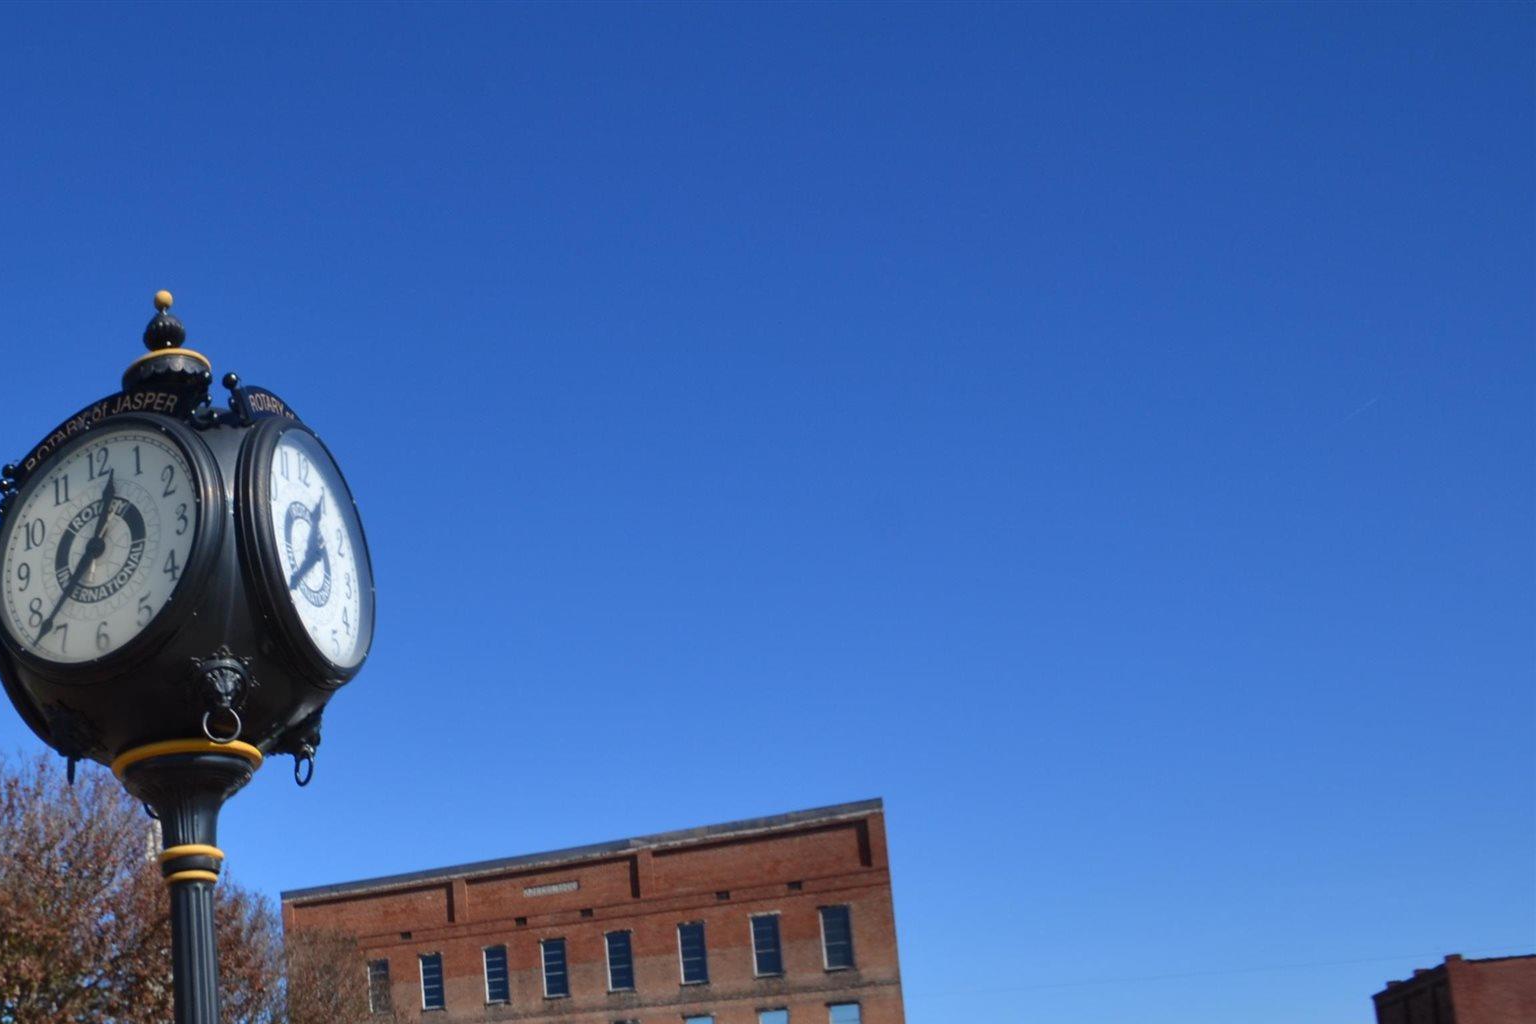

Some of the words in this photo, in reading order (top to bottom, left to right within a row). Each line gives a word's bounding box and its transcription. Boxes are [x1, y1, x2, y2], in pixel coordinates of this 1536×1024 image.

[112, 392, 178, 415] JASPER
[248, 392, 284, 417] ROTARY
[86, 446, 110, 481] 12
[132, 445, 144, 476] 1
[52, 473, 70, 508] 11
[161, 464, 177, 498] 2
[23, 517, 46, 552] 10
[175, 503, 189, 536] 3
[17, 562, 31, 593] 9
[57, 542, 145, 602] INERNATIONAL
[163, 549, 181, 582] 4
[28, 597, 44, 628] 8
[137, 590, 154, 628] 5
[54, 622, 69, 654] 7
[95, 620, 110, 651] 6
